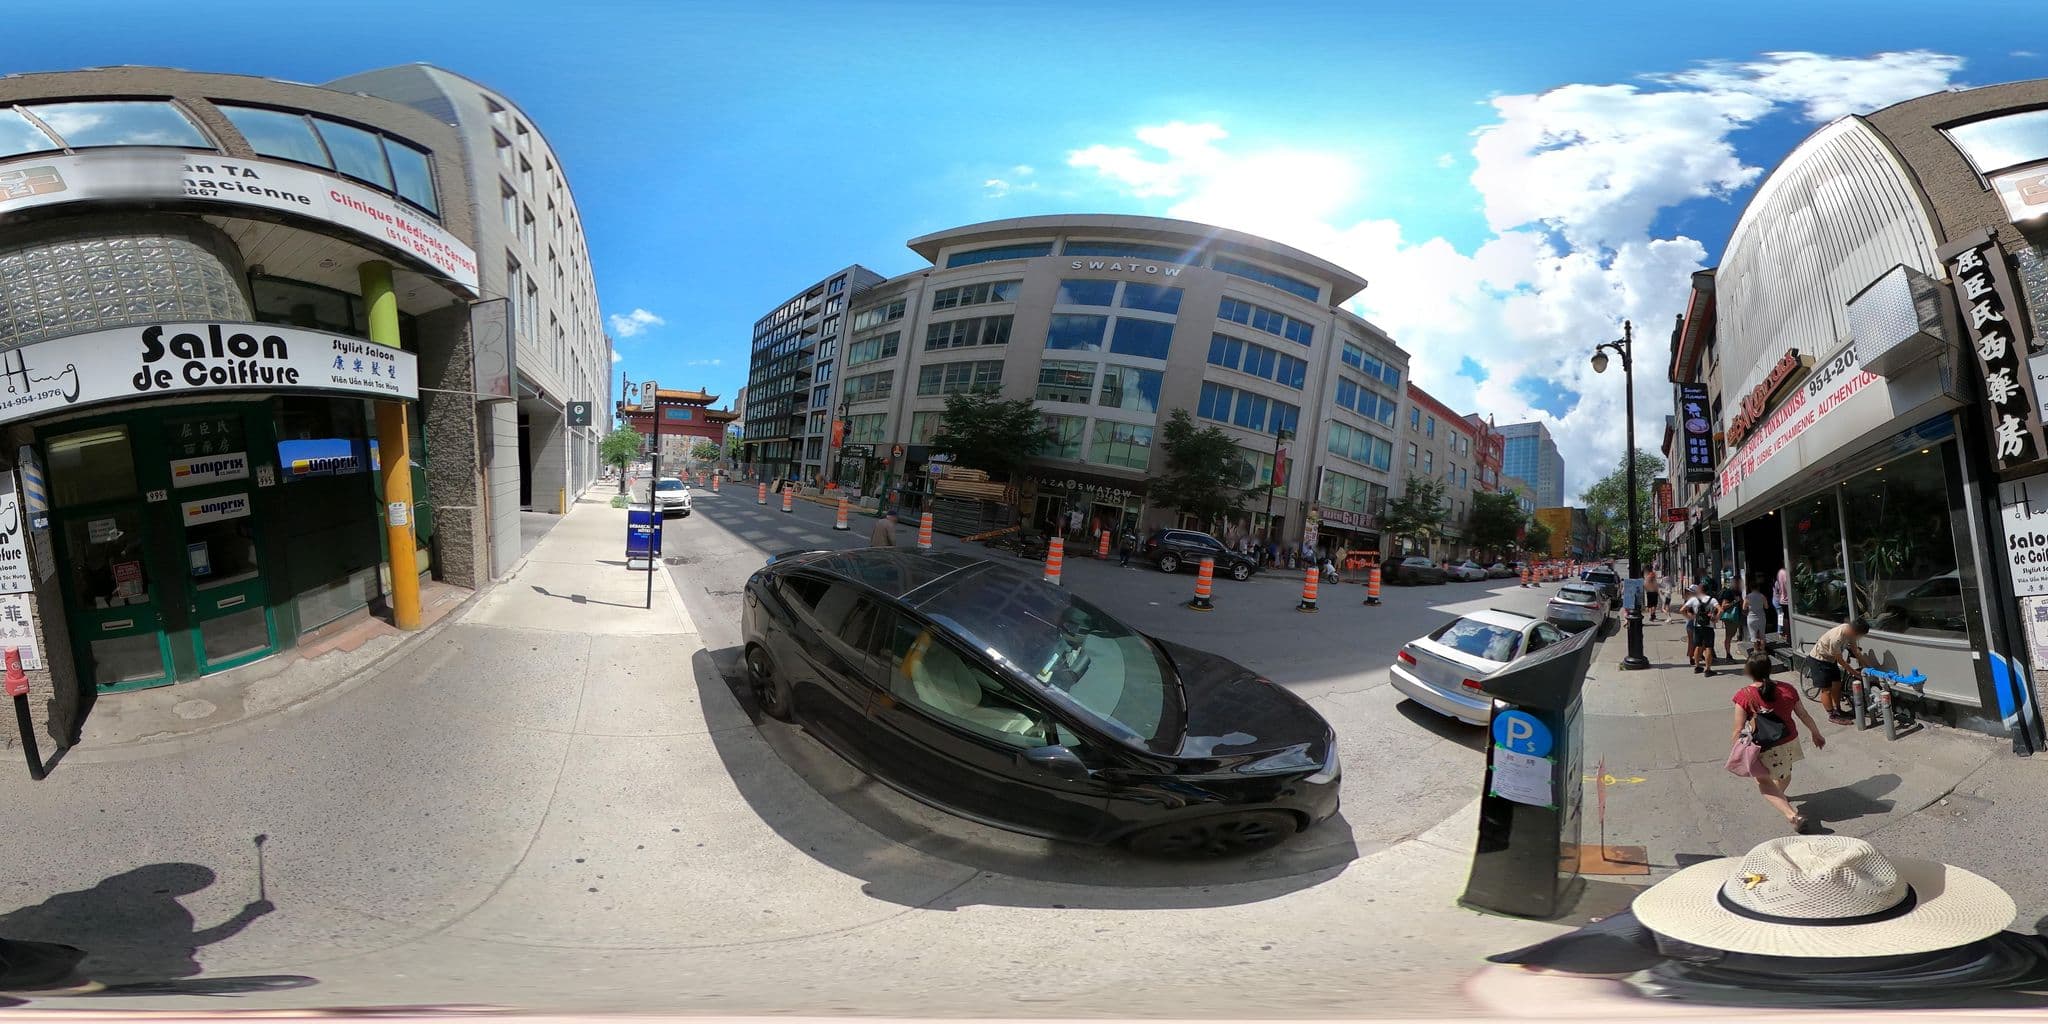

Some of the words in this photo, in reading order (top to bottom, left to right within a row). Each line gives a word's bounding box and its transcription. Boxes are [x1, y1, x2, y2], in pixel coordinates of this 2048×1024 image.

[221, 164, 260, 179] TA
[330, 190, 393, 225] Clinique
[386, 226, 411, 247] (514)
[1071, 260, 1181, 277] SWATOW
[141, 324, 288, 363] Salon
[332, 339, 363, 354] Stylist
[365, 346, 395, 361] Saloon
[132, 364, 173, 391] de
[182, 358, 300, 386] Coiffure
[0, 388, 61, 410] 14-954-1976
[645, 383, 652, 395] P
[1763, 387, 1807, 438] TONKINOISE
[1809, 346, 1859, 397] 954-20
[190, 458, 244, 476] uniprix
[309, 456, 359, 476] uniprix
[1078, 483, 1132, 498] SWATOW
[201, 499, 245, 514] uniprix
[2009, 532, 2048, 550] Salo
[2014, 552, 2026, 565] de
[1505, 716, 1533, 748] P
